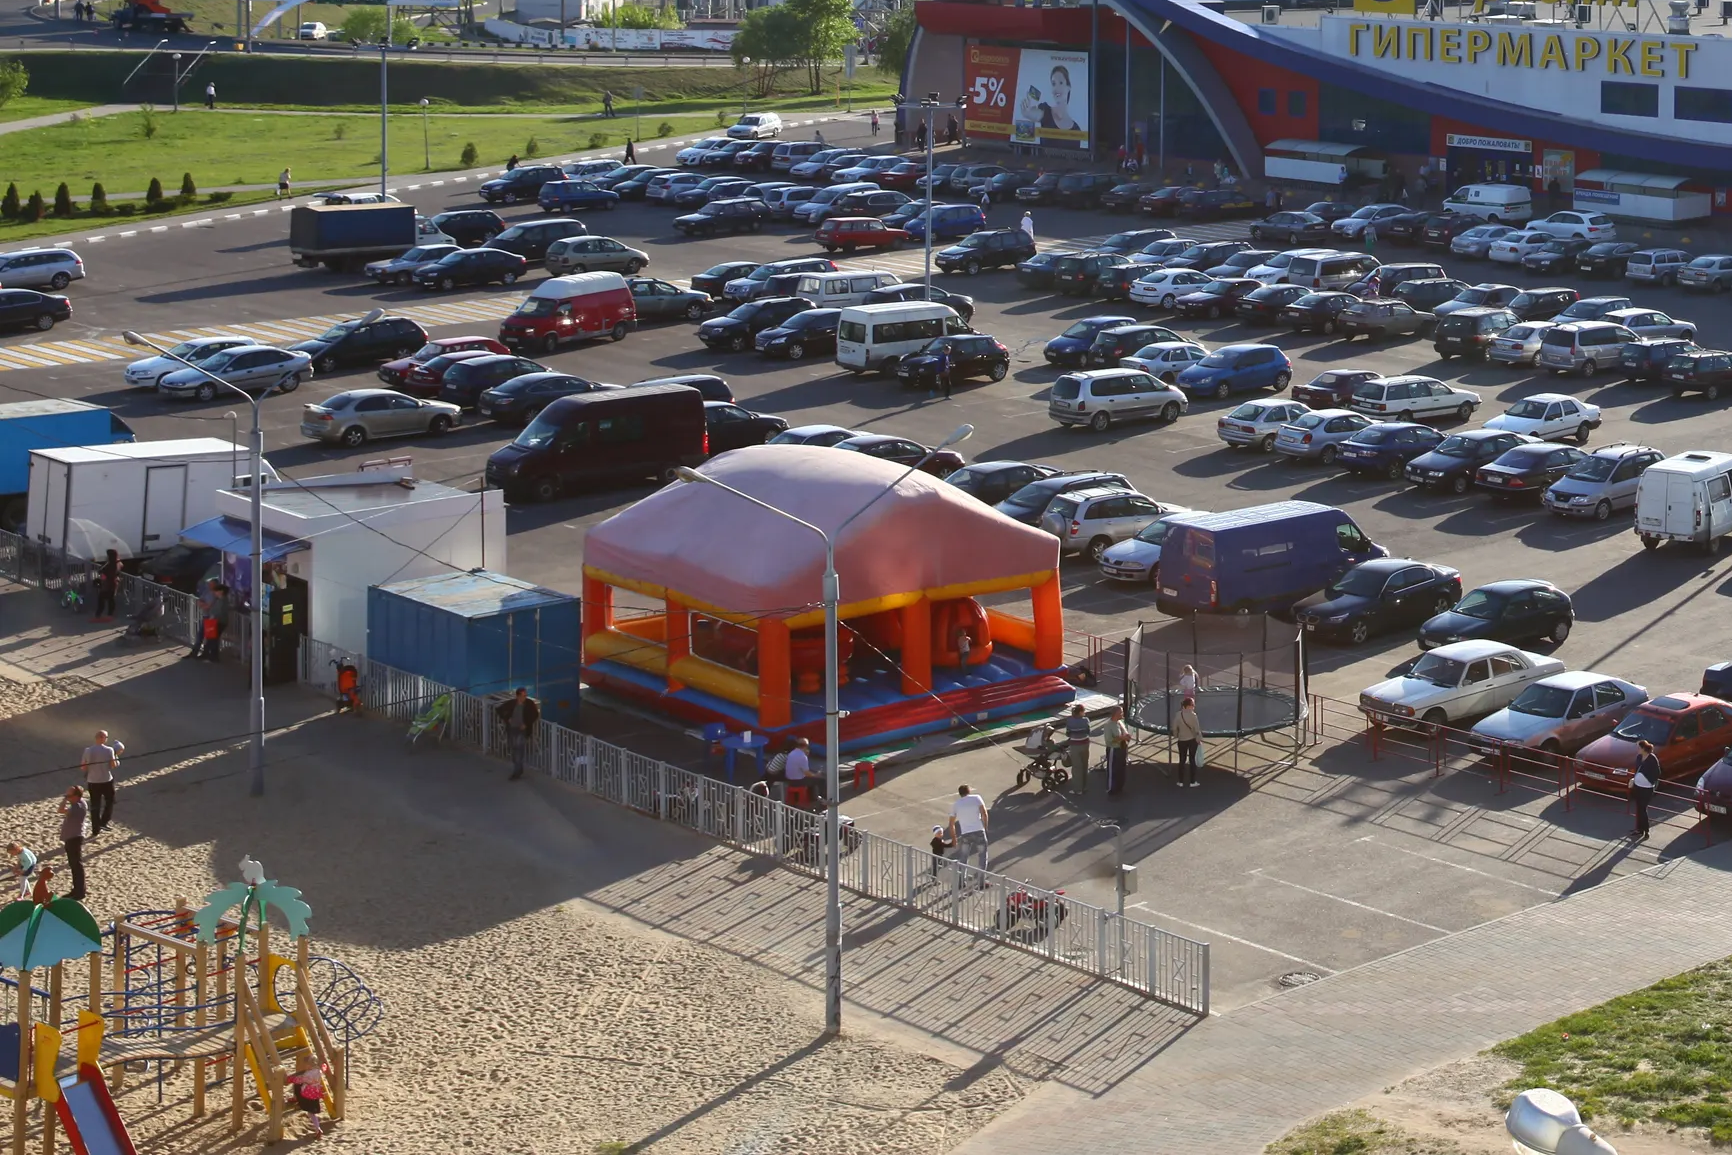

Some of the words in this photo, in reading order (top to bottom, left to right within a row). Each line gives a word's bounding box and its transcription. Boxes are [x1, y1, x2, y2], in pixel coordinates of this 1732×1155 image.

[1349, 23, 1699, 80] ГИПЕРМАРКЕТ
[969, 76, 1007, 107] -5%
[1456, 137, 1478, 146] ДОБРО
[1477, 138, 1521, 149] ПОЖАЛОВАТЬ!
